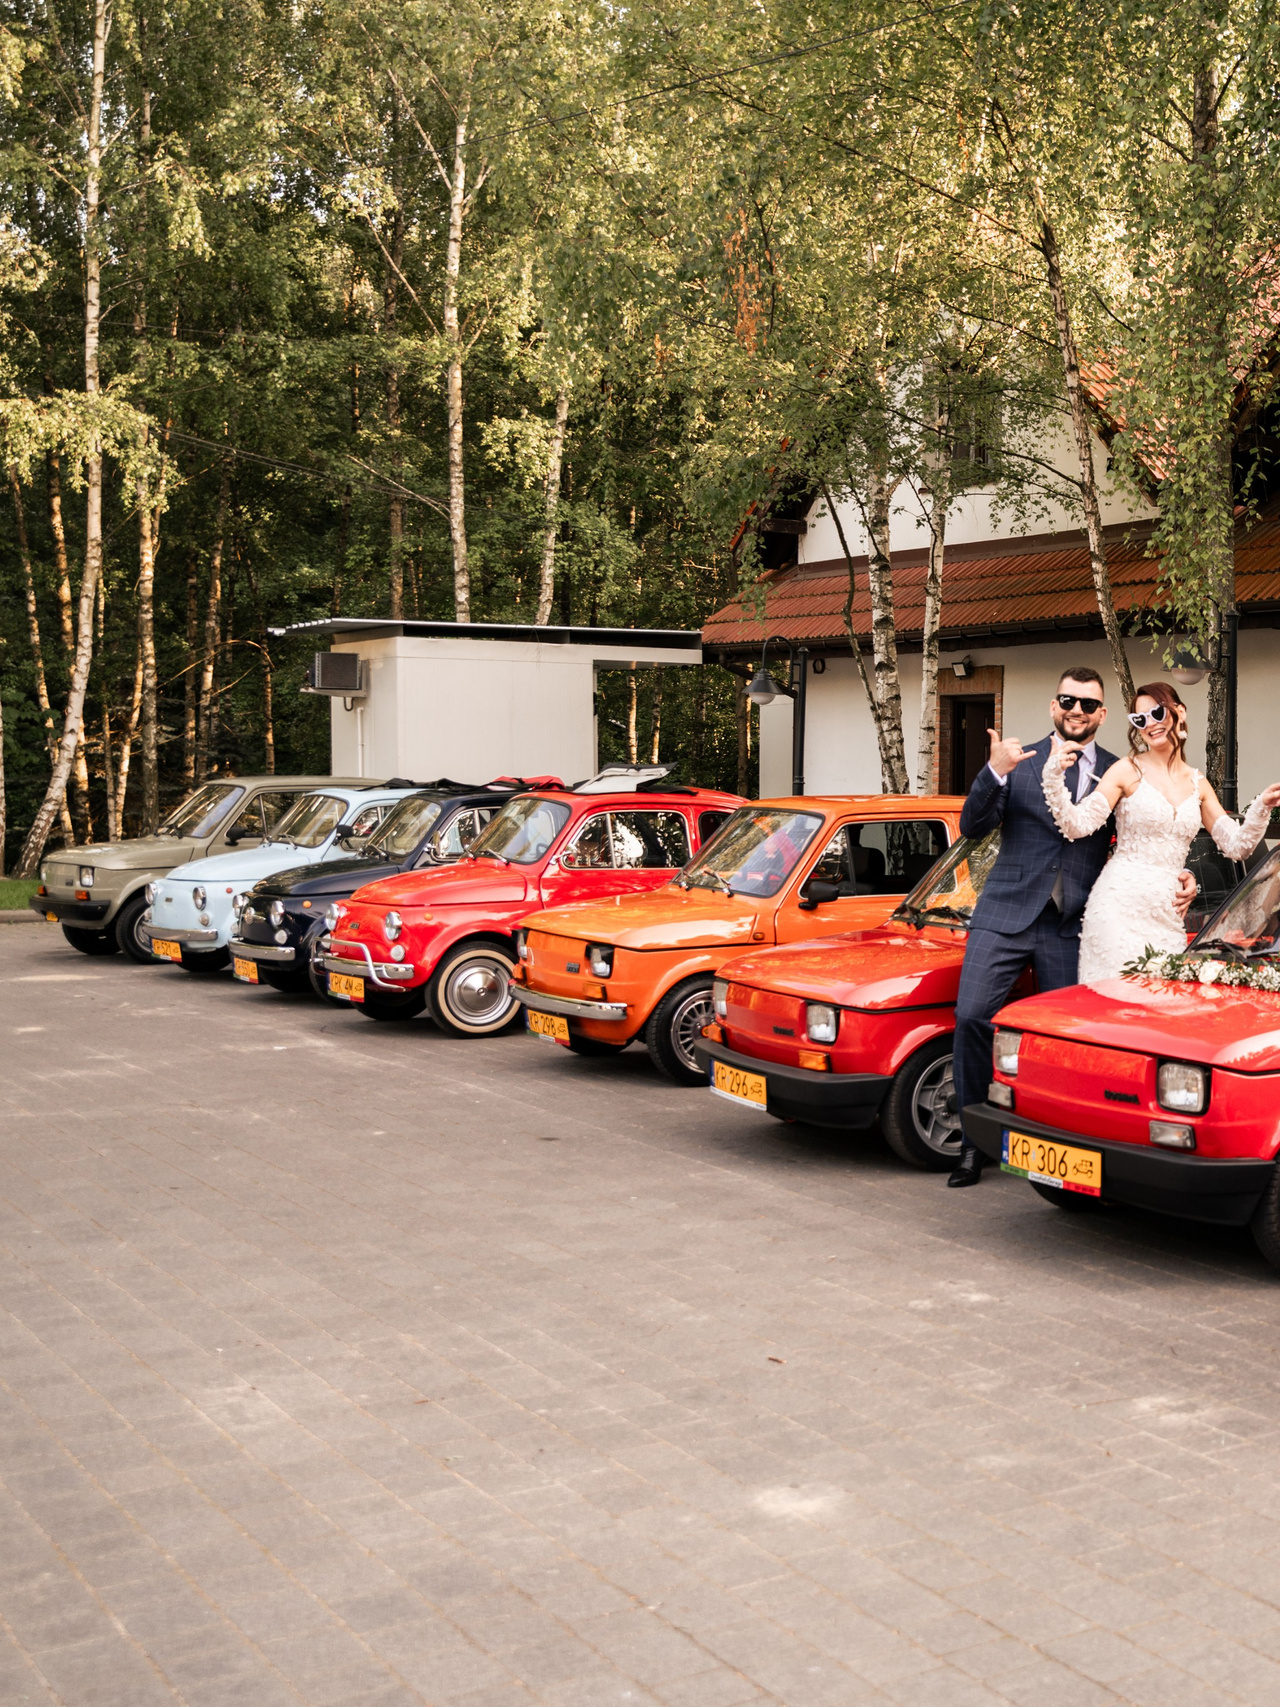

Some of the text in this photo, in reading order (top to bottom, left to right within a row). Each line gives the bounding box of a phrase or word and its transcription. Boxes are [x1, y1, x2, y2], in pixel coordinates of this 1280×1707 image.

[529, 1012, 557, 1036] KR 298
[715, 1064, 749, 1097] KR 296
[1011, 1136, 1068, 1178] KR 306
